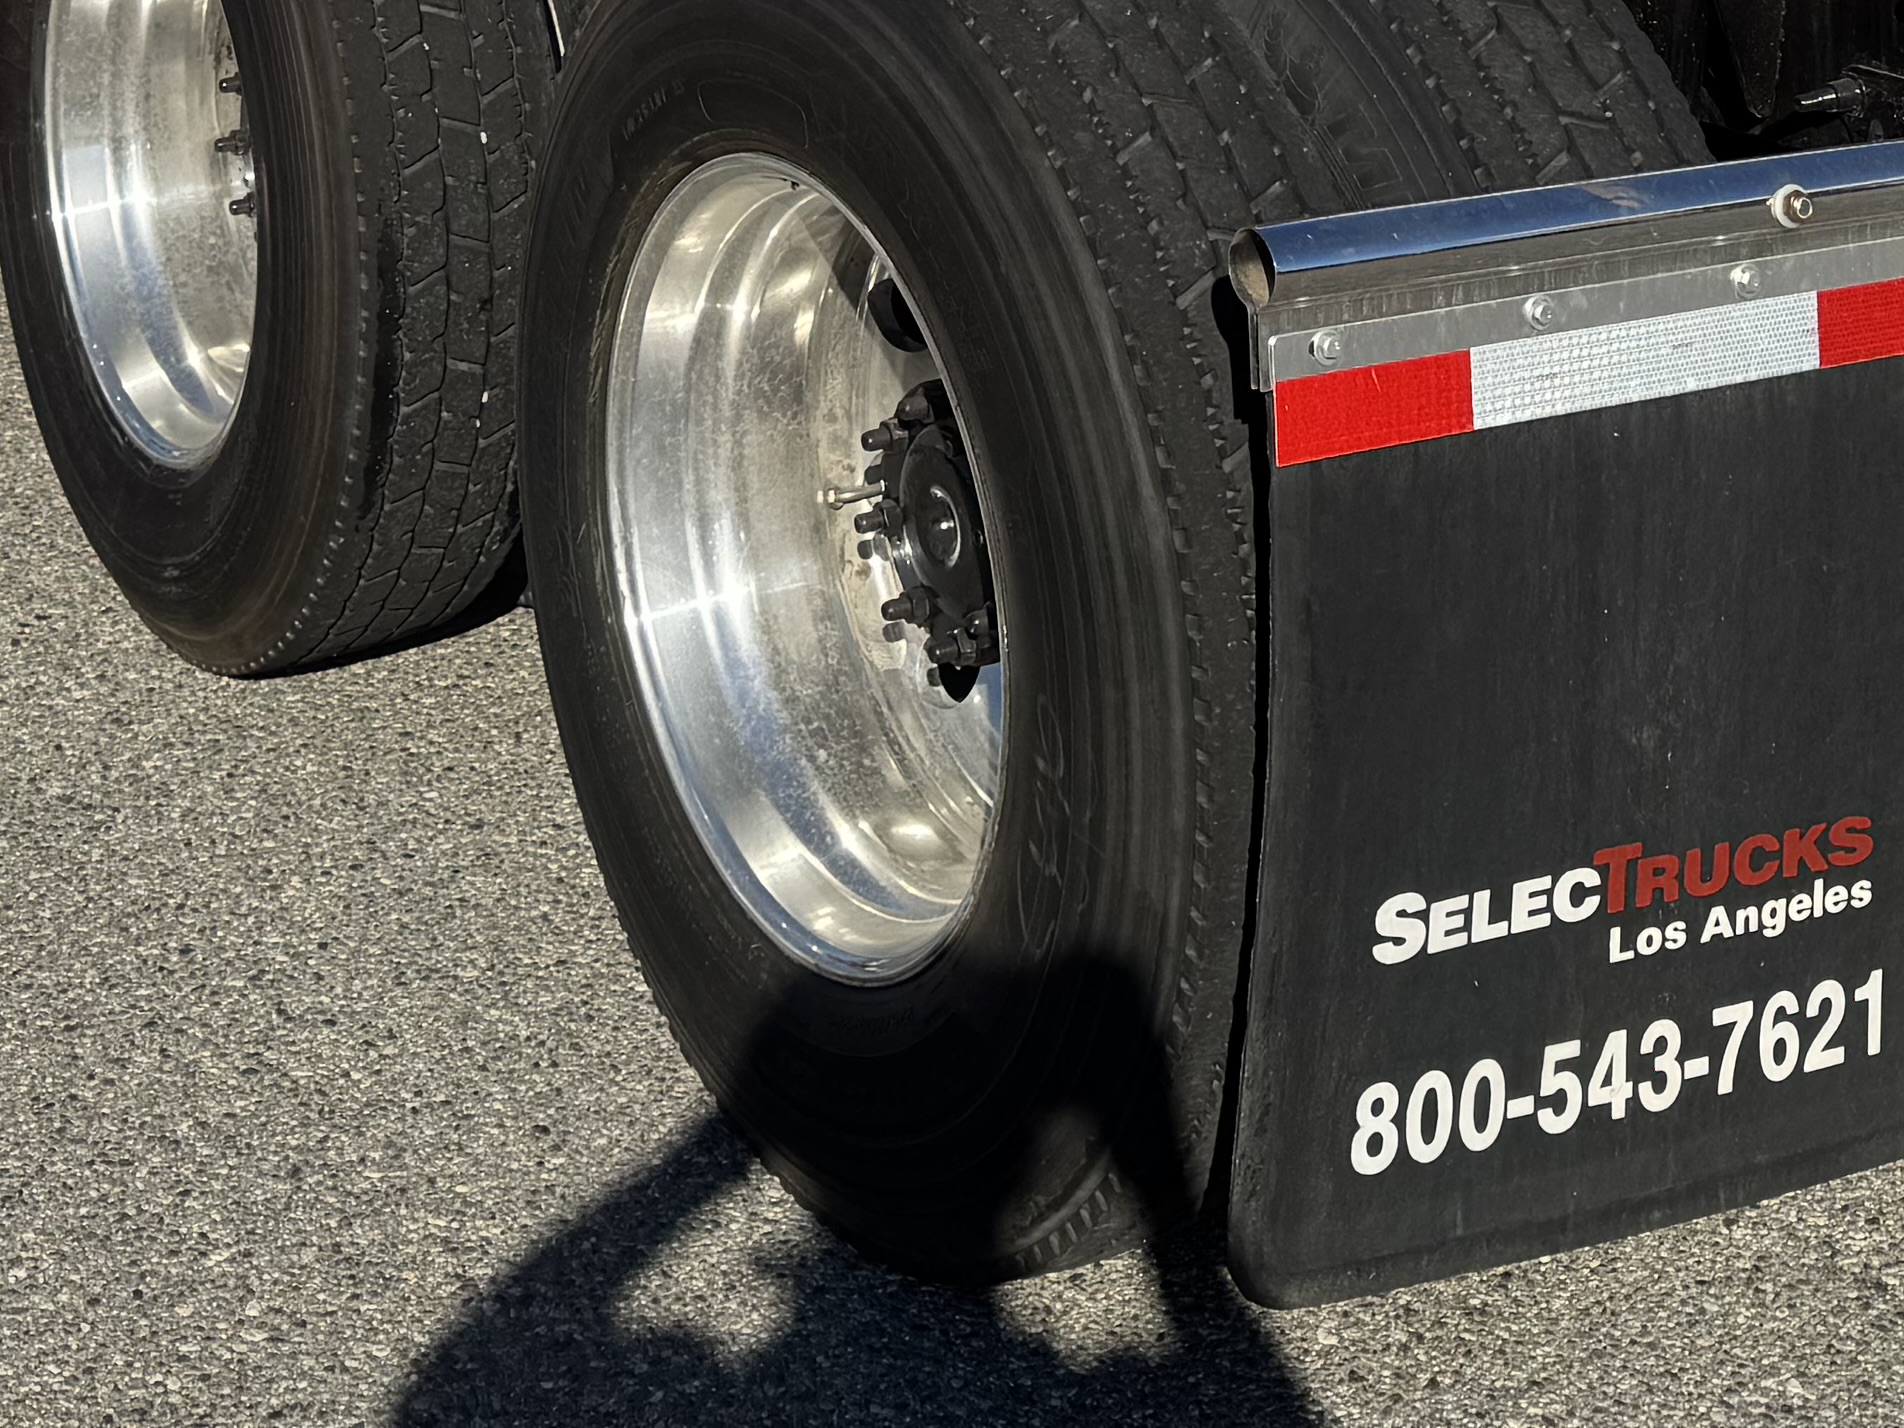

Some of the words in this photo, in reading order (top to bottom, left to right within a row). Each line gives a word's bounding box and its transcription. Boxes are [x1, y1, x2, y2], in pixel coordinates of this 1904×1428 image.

[1608, 920, 1688, 964] Los
[1699, 877, 1874, 945] Angeles
[1350, 968, 1884, 1176] 800-543-7621
